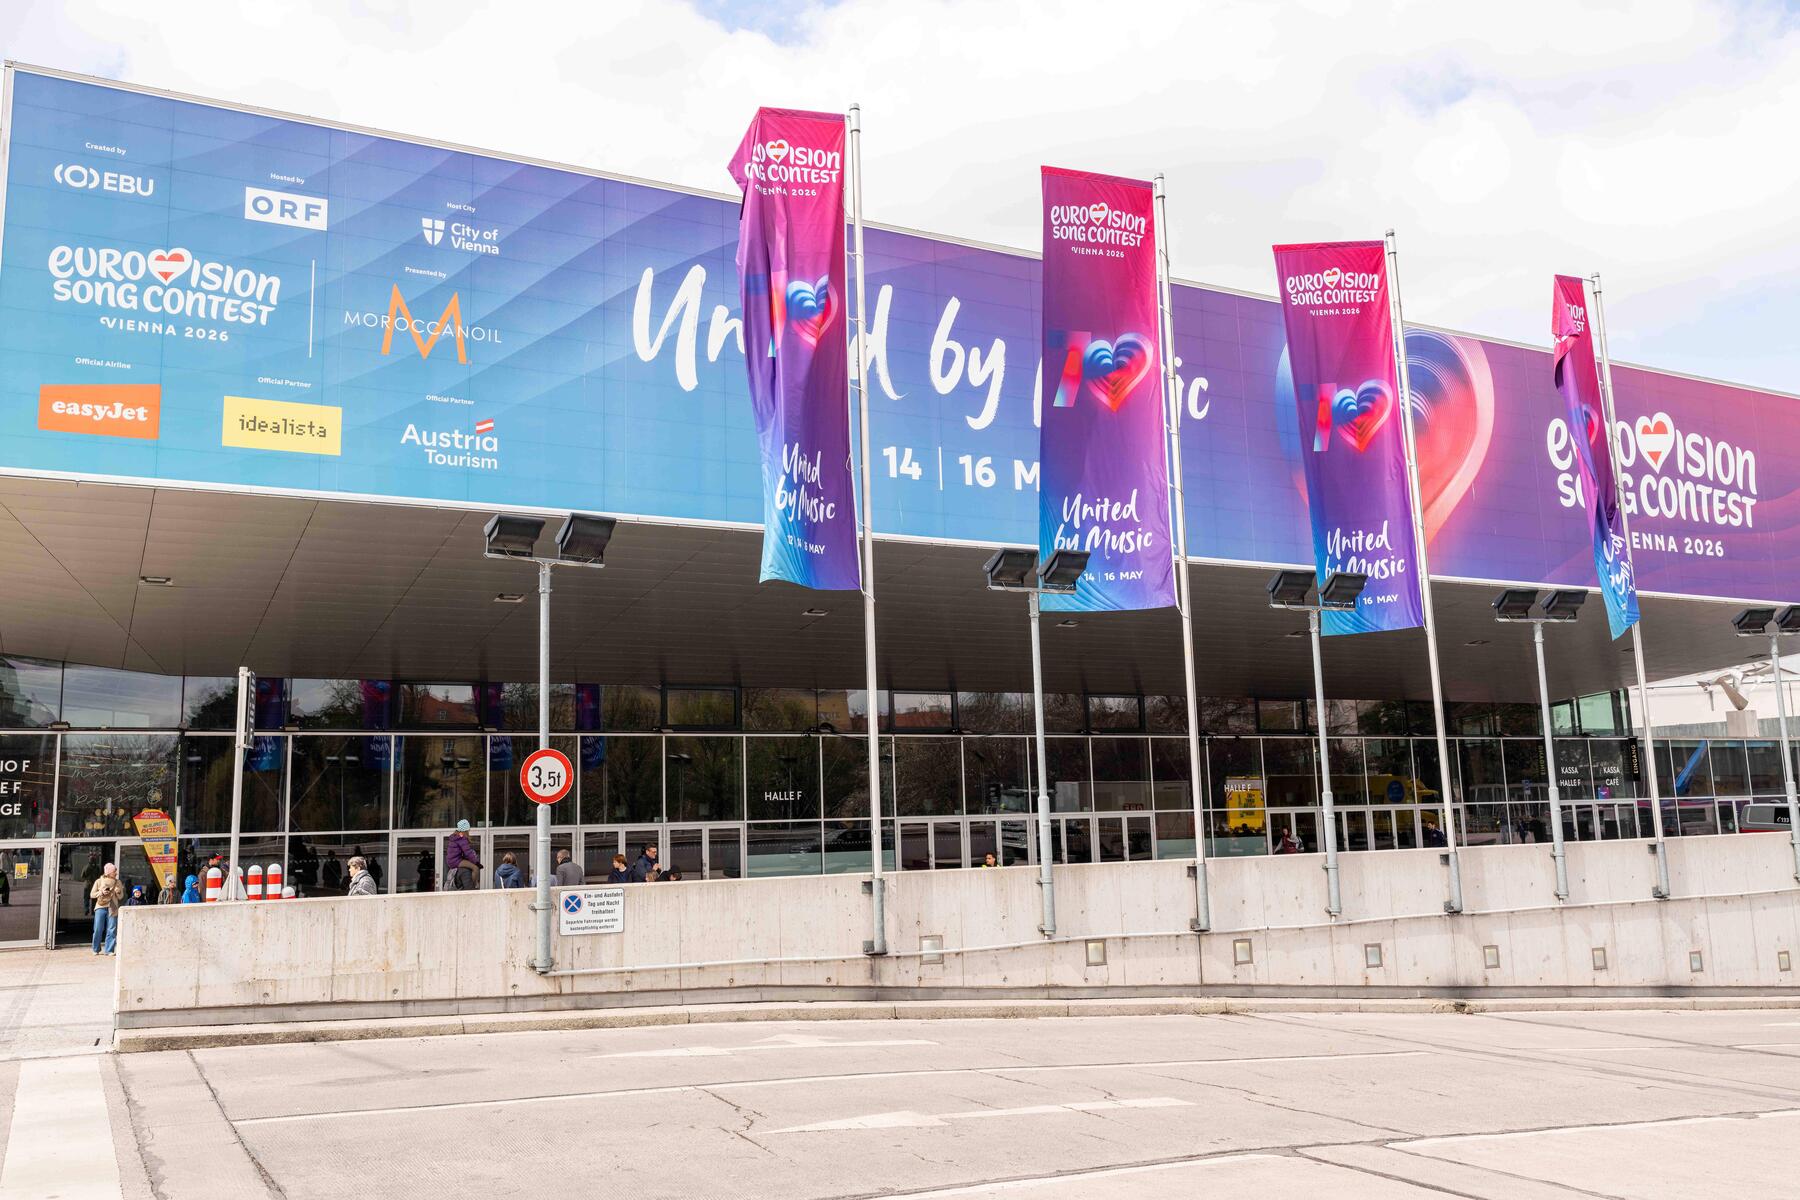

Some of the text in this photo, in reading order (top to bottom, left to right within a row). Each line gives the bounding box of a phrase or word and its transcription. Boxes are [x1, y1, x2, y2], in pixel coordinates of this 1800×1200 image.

[86, 142, 127, 156] Created by
[104, 172, 154, 196] EBU
[270, 172, 305, 185] Hosted by
[791, 188, 816, 196] 2026
[252, 196, 322, 222] ORF
[446, 202, 476, 214] Host City
[451, 222, 499, 241] City of
[451, 236, 500, 255] Vienna
[1071, 246, 1125, 258] VIENNA 2026
[405, 266, 447, 279] Presented by
[1310, 308, 1340, 316] VIENNA
[100, 316, 229, 342] VIENNA 2026
[344, 310, 502, 344] MOROCCANOIL
[75, 357, 132, 370] Official Airline
[930, 296, 1006, 431] by
[258, 376, 312, 388] Official Partner
[426, 394, 475, 406] Official Partner
[51, 400, 148, 422] easyJet
[238, 414, 328, 438] idealista
[400, 421, 498, 452] Austria
[424, 448, 499, 470] Tourism
[882, 446, 923, 480] 14
[958, 454, 997, 488] 16
[775, 474, 797, 522] by
[1062, 488, 1142, 530] United
[1084, 525, 1152, 560] Music
[1326, 520, 1393, 560] United
[808, 544, 826, 554] MAY
[1684, 538, 1724, 558] 2026
[1084, 570, 1144, 581] 14 16 MAY
[1362, 594, 1399, 605] 16 MAY
[1630, 744, 1639, 774] EINGANG
[22, 760, 30, 772] F
[1560, 766, 1579, 774] KASSA
[1602, 766, 1620, 774] KASSA
[531, 766, 562, 790] 3,5t
[1560, 779, 1578, 787] HALLE
[1605, 777, 1620, 786] CAFÉ
[13, 782, 22, 794] F
[1224, 784, 1252, 792] HALLE F
[764, 790, 802, 801] HALLE F
[0, 804, 22, 816] GE
